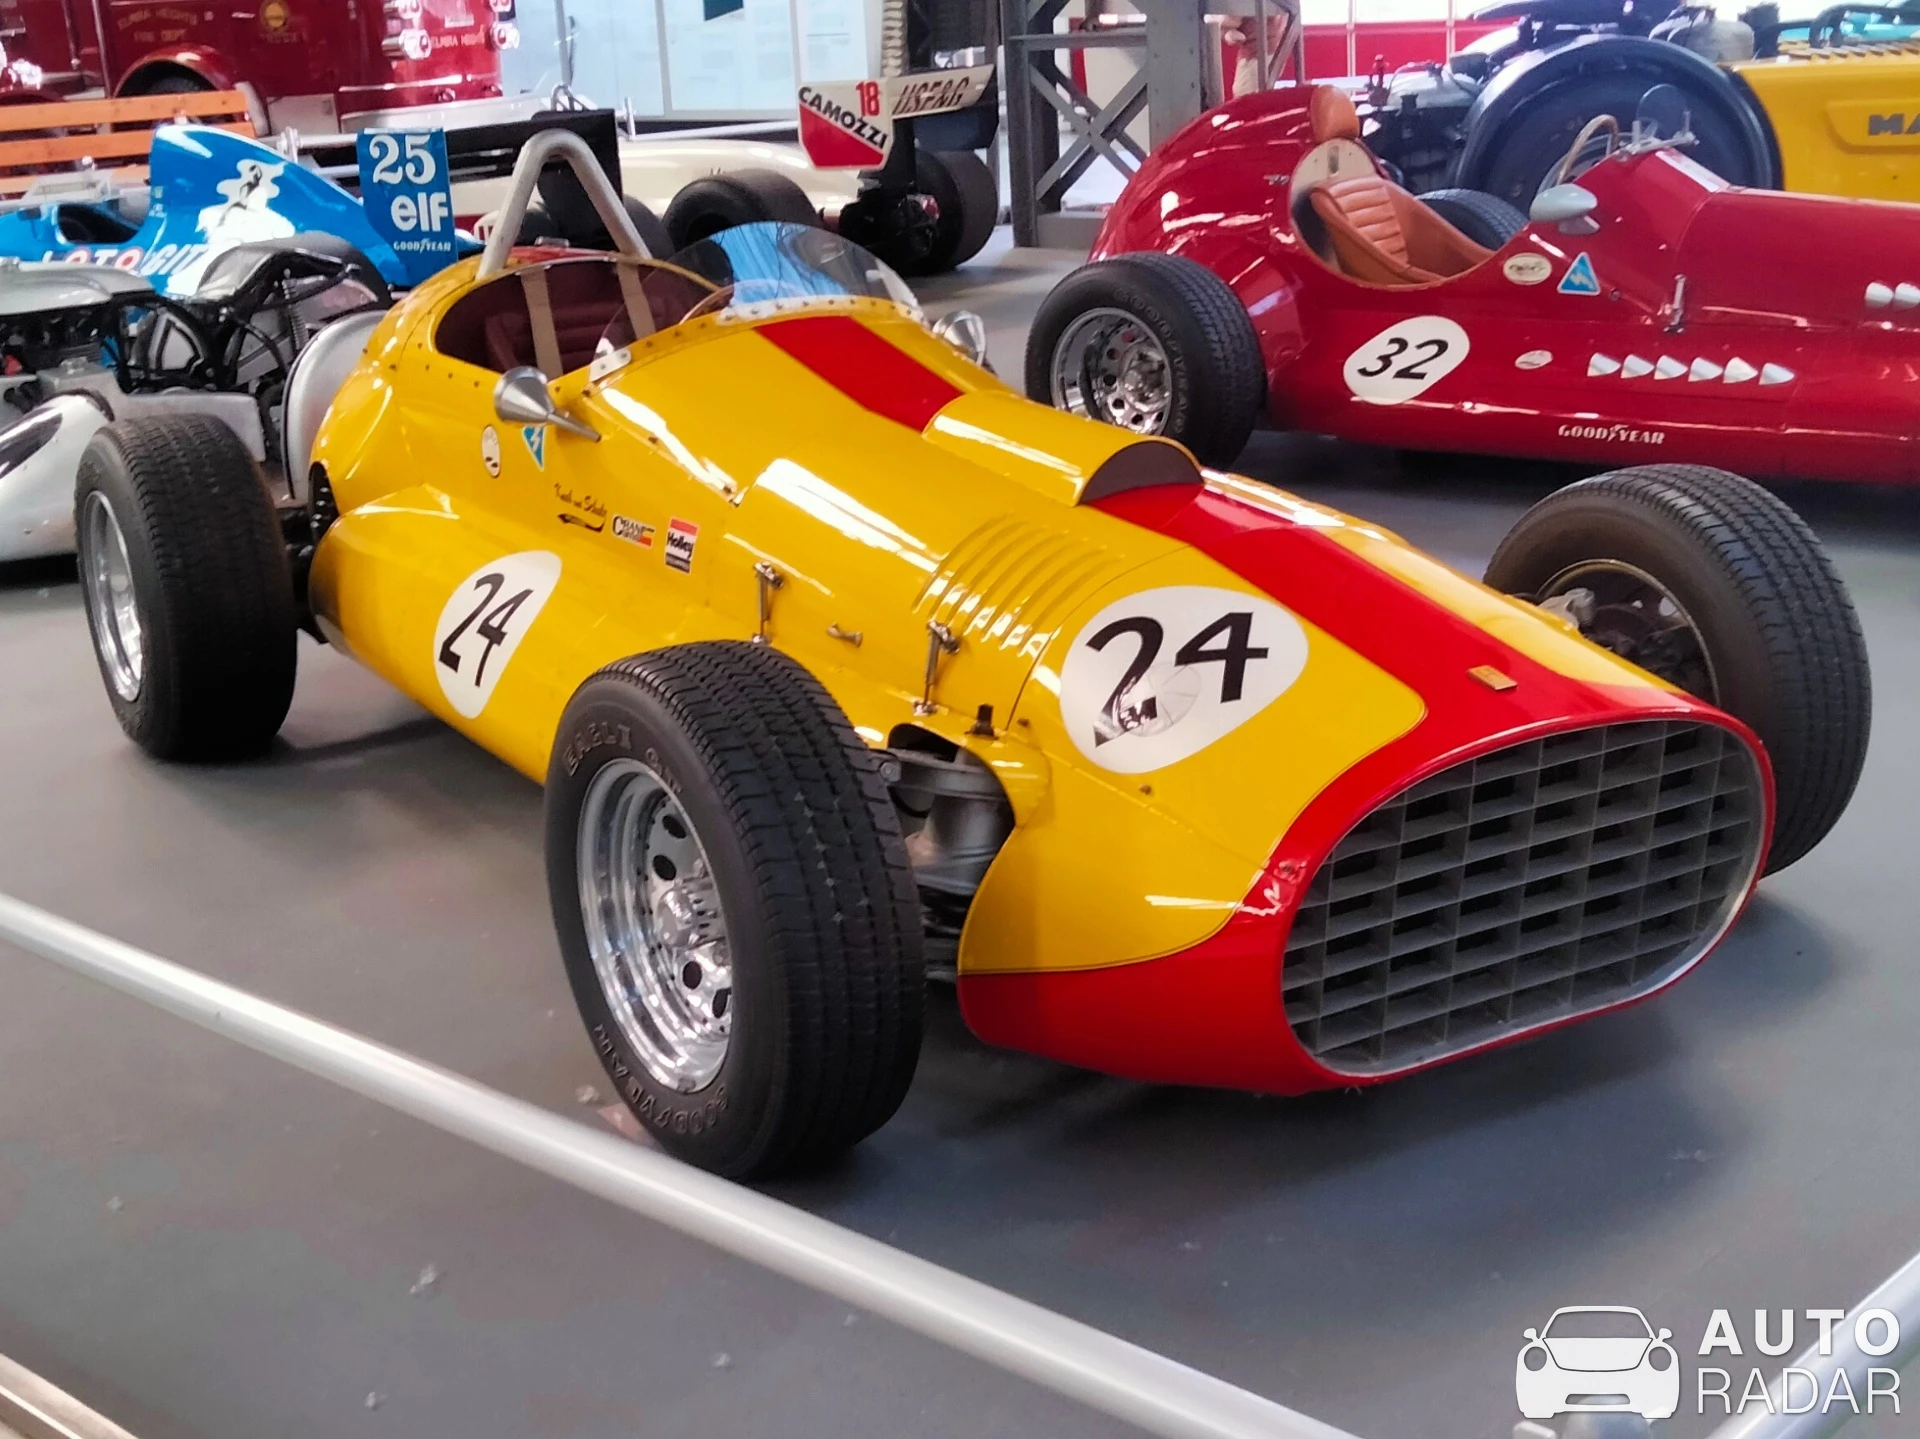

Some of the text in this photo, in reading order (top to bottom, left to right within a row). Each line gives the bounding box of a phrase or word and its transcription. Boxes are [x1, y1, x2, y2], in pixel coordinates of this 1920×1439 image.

[855, 80, 881, 117] 18
[892, 75, 970, 116] USF&G
[797, 86, 889, 150] CAMOZZI
[368, 133, 437, 185] 25
[390, 191, 449, 232] elf
[393, 238, 452, 253] GOODYEAR
[1356, 336, 1449, 380] 32
[1558, 424, 1665, 445] GOODYEAR
[438, 572, 535, 688] 24
[1085, 611, 1269, 748] 24
